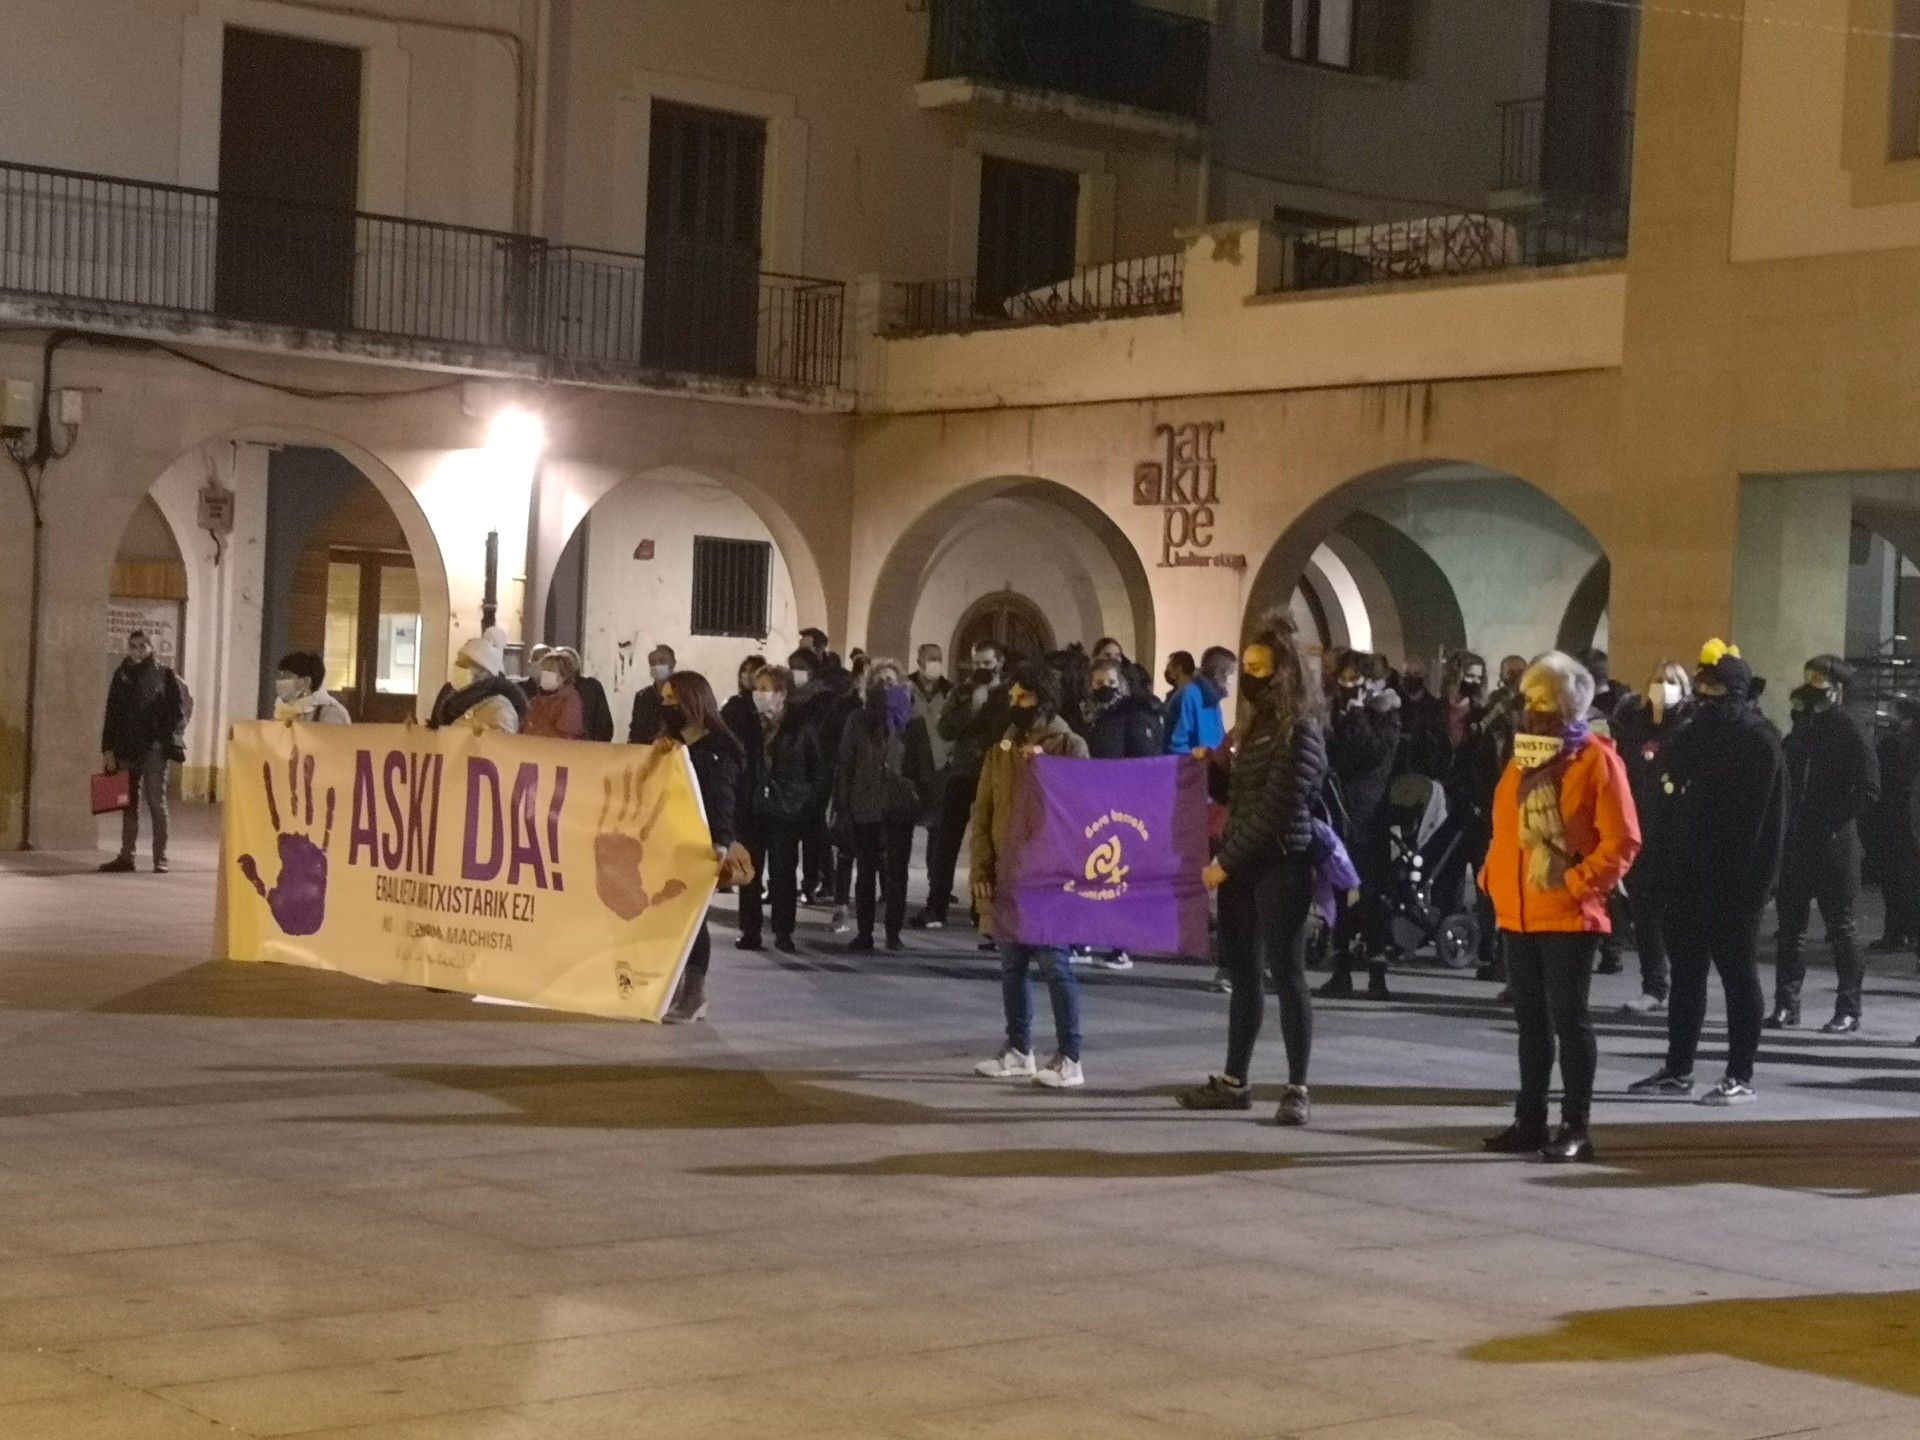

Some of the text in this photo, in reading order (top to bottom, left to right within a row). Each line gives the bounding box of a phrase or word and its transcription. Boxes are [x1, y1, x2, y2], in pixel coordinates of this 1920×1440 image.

[348, 750, 569, 892] ASKI DA!
[512, 892, 535, 923] EZ!
[446, 926, 513, 951] MACHISTA
